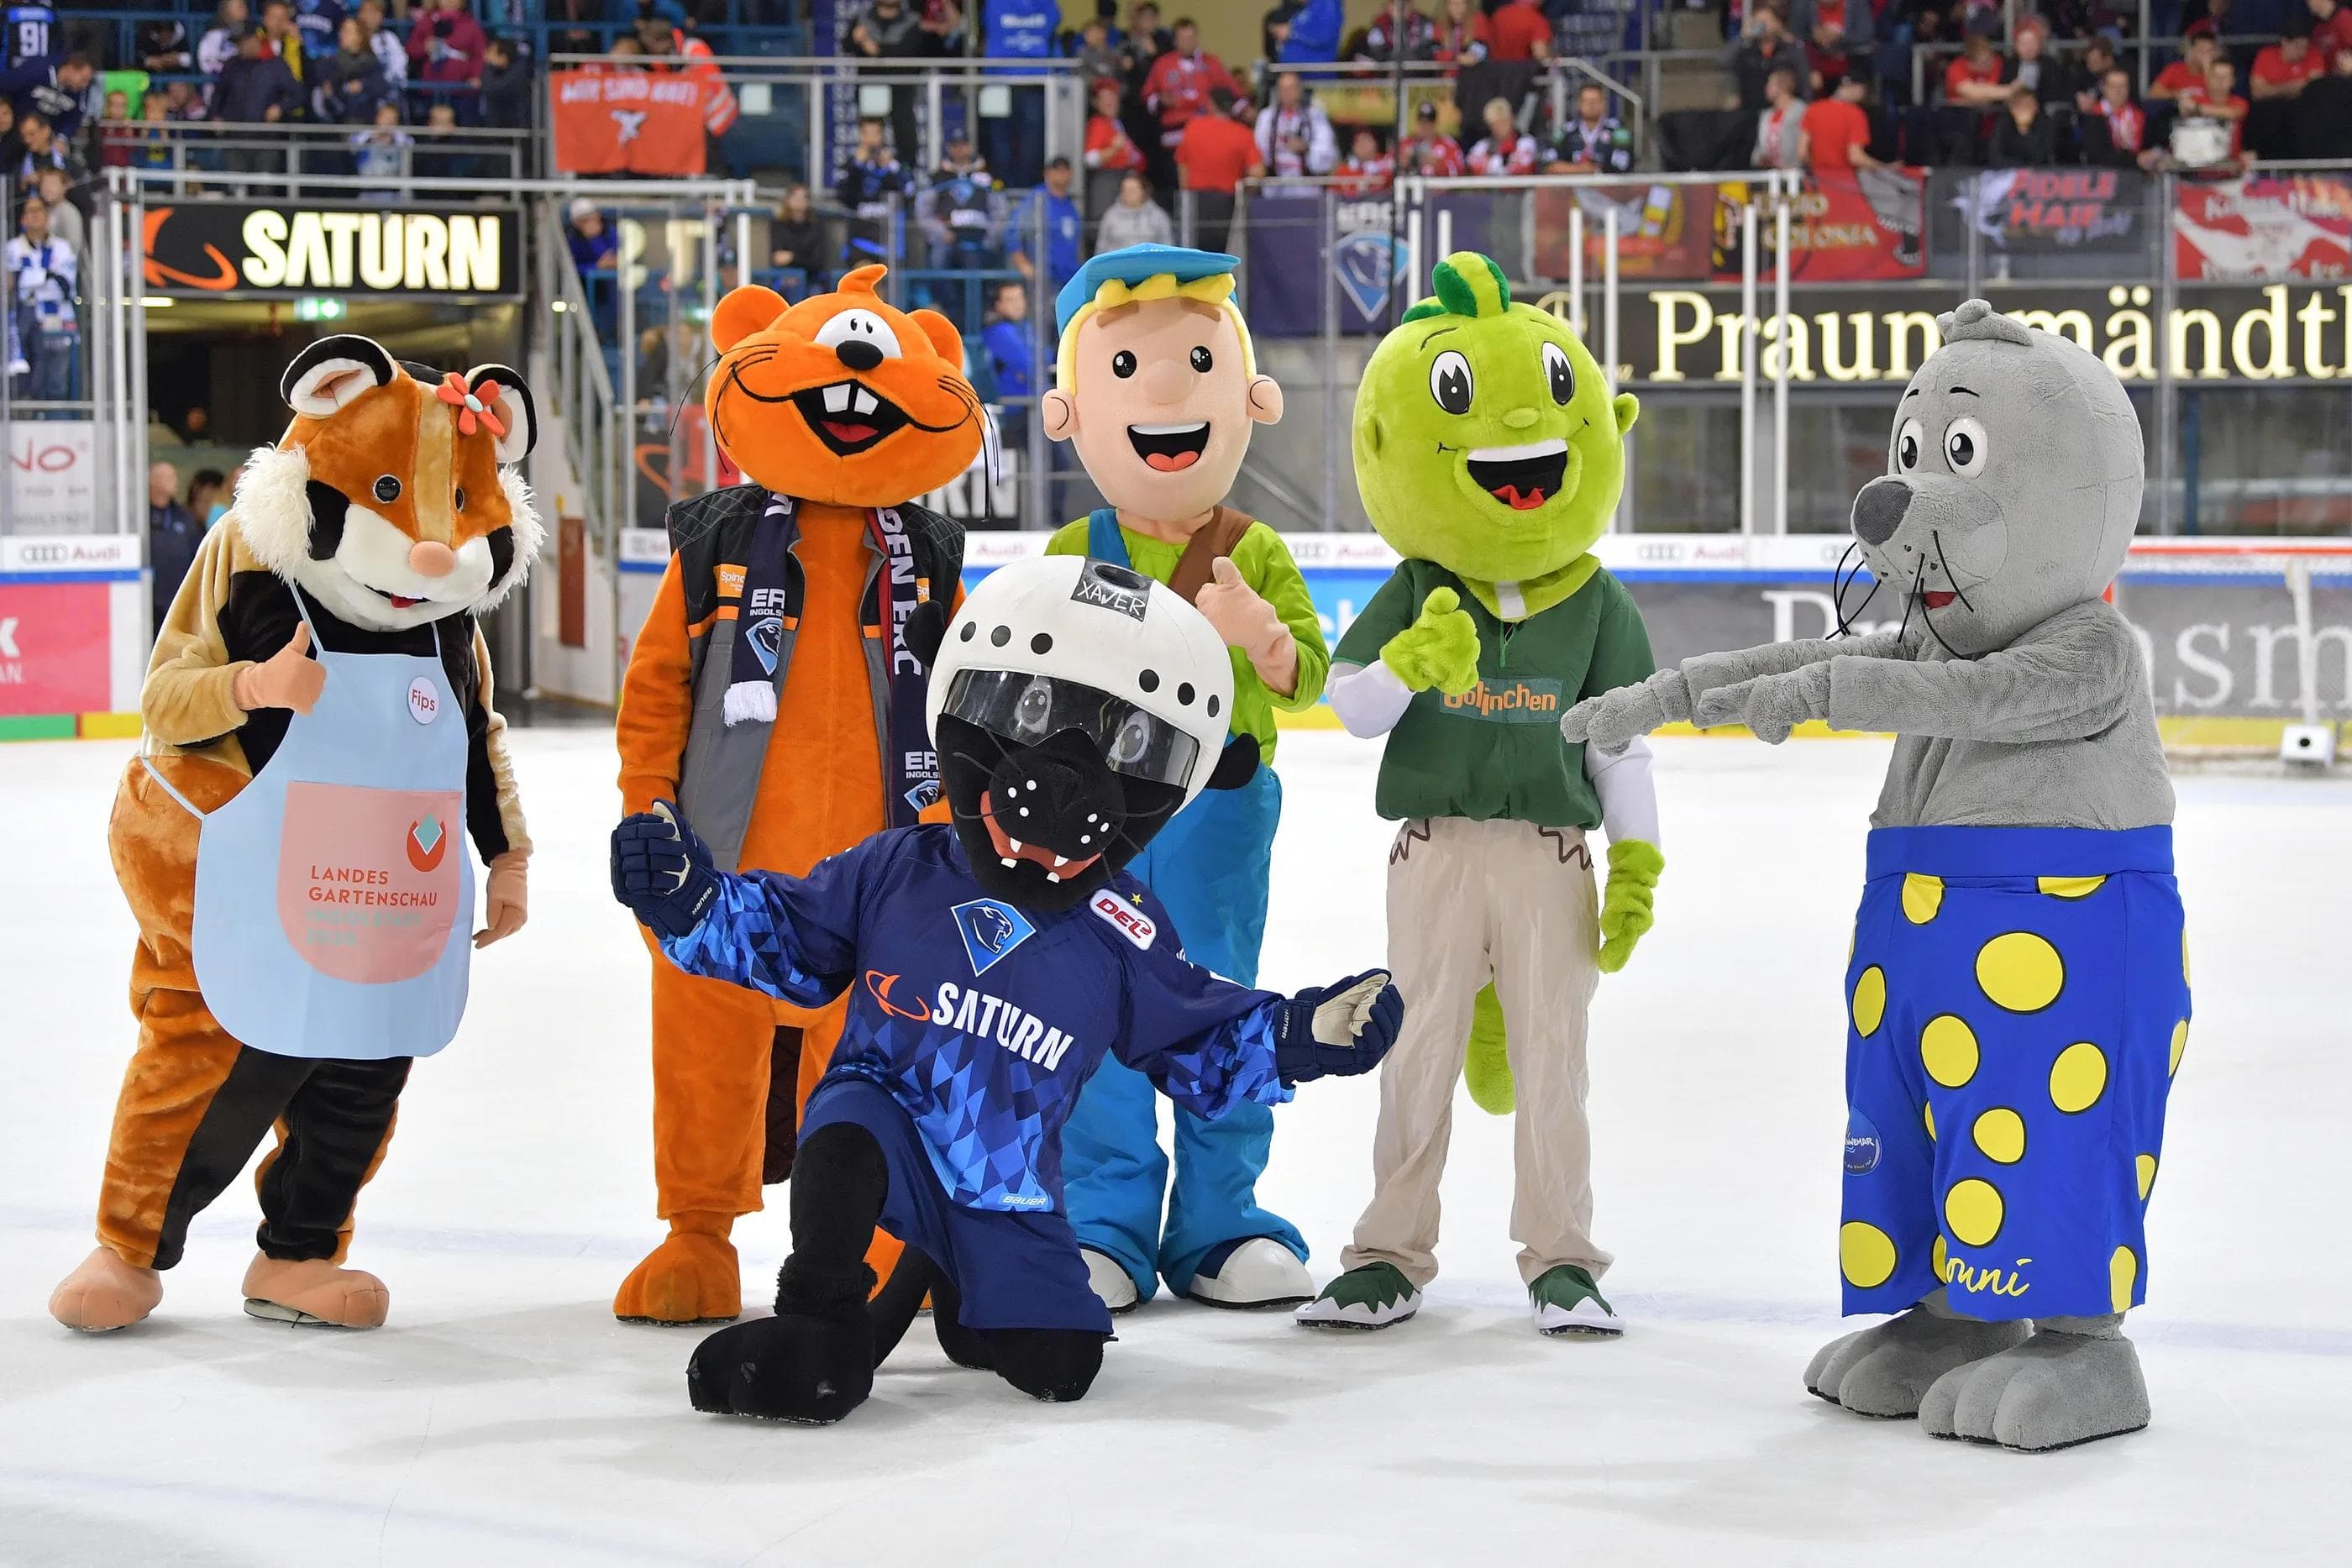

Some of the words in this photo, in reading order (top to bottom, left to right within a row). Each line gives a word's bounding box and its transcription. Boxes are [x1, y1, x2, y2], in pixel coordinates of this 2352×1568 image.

[19, 21, 49, 57] 91
[241, 209, 501, 291] SATURN
[72, 545, 122, 561] Audi
[1077, 580, 1146, 616] XAVER
[412, 689, 435, 711] Fips
[906, 771, 941, 779] INGOLS
[311, 865, 389, 885] LANDES
[308, 886, 438, 907] GARTENSCHAU
[1096, 898, 1152, 939] DEL
[932, 982, 1074, 1072] SATURN
